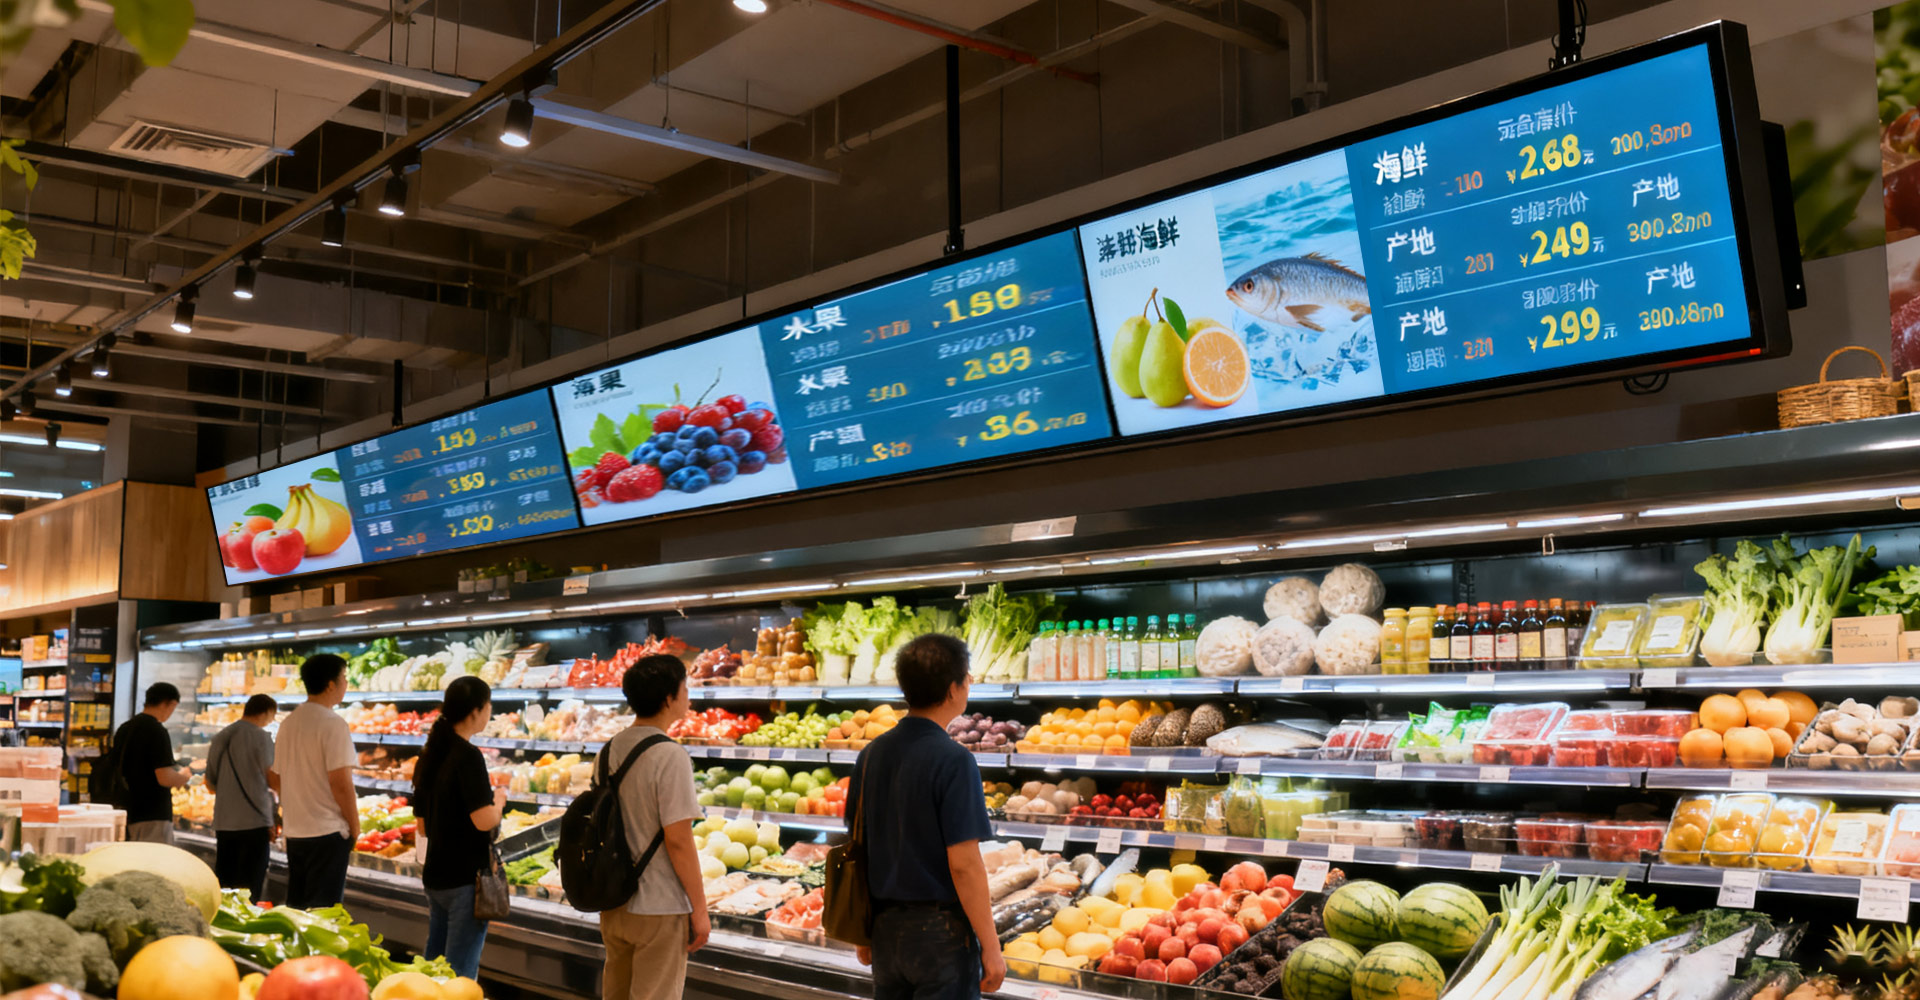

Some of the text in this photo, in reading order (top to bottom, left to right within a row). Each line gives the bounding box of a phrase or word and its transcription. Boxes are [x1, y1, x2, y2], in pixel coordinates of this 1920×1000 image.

[1372, 141, 1428, 185] 海鲜
[1632, 172, 1681, 207] 产地
[1386, 226, 1437, 262] 产地
[1646, 261, 1696, 294] 产地
[1399, 305, 1448, 342] 产地
